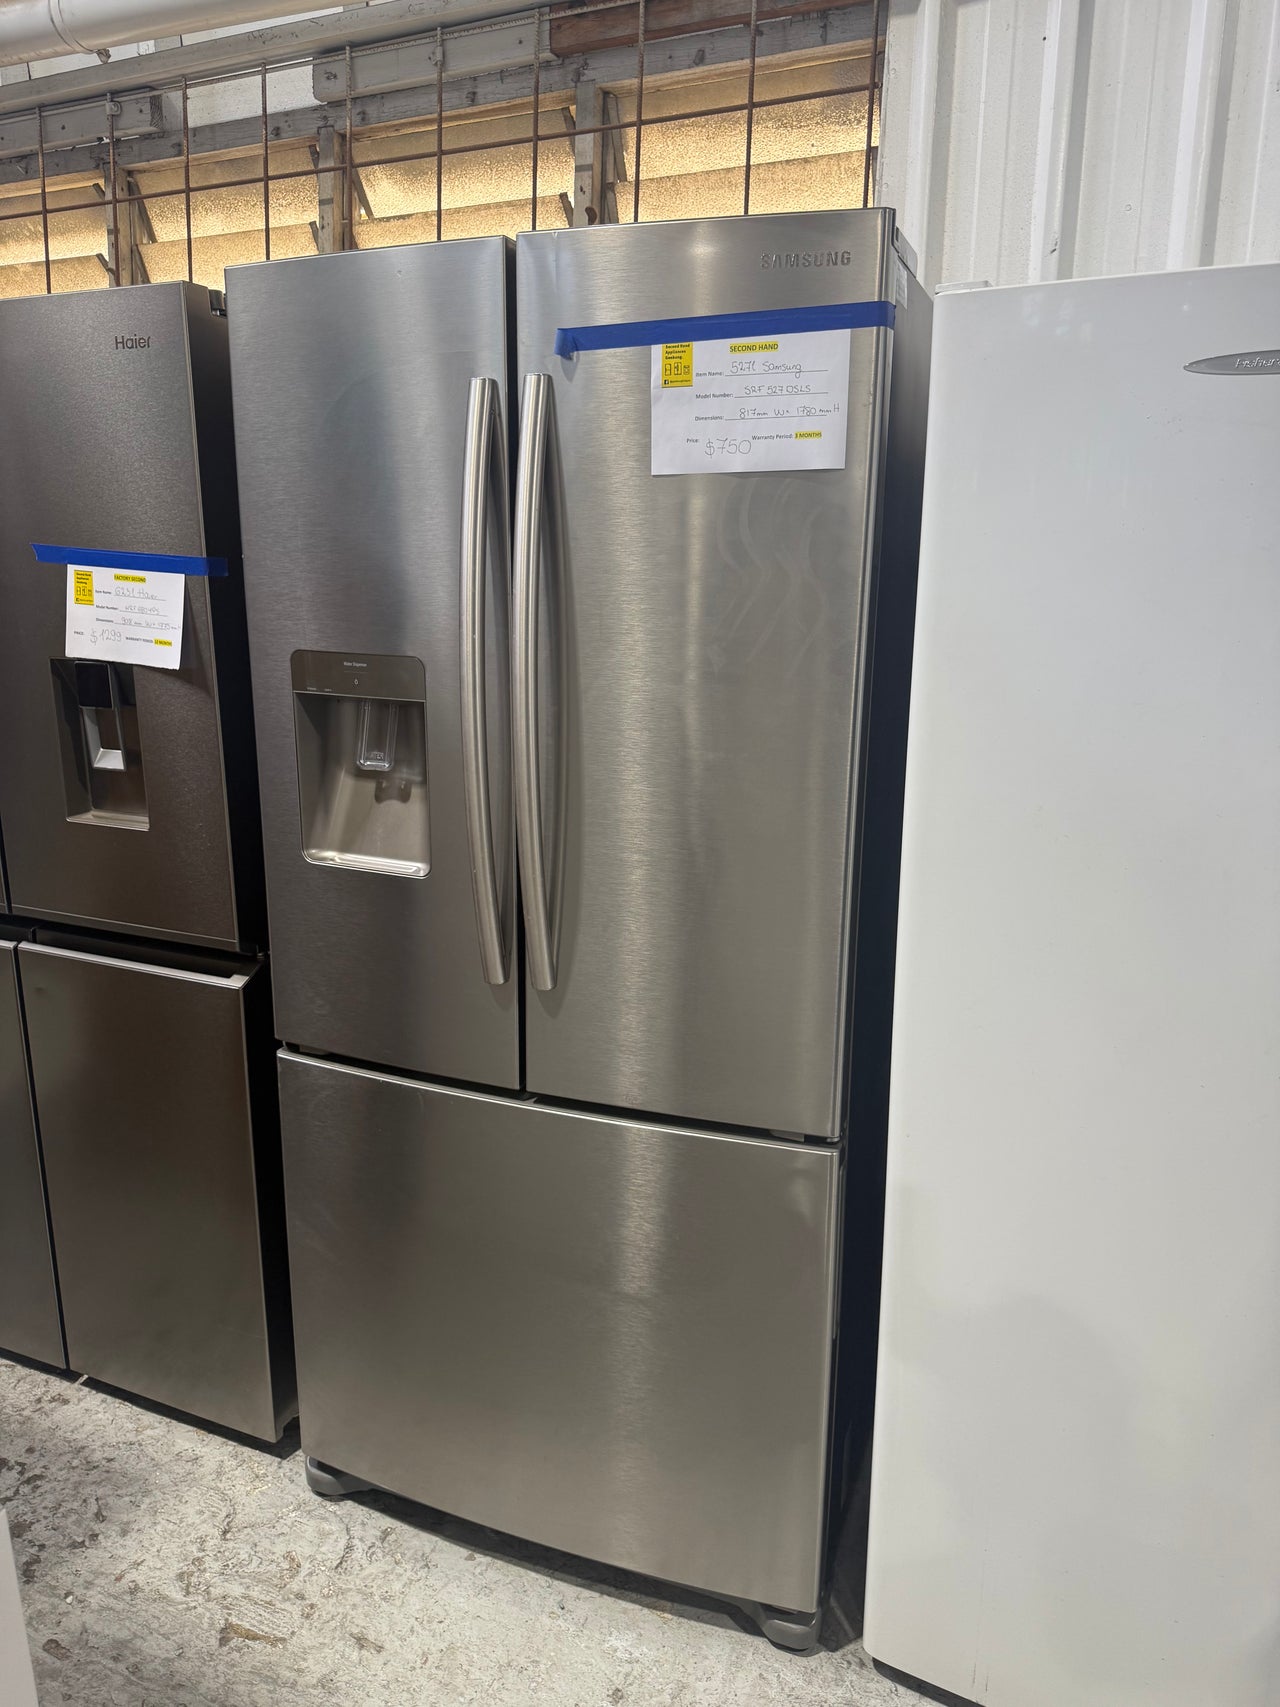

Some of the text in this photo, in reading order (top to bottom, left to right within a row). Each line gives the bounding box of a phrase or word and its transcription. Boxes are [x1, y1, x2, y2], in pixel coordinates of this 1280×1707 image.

[760, 250, 851, 269] SAMSUNG
[114, 334, 150, 350] Haier
[730, 344, 756, 353] SECOND
[762, 361, 802, 379] Samsung
[704, 438, 752, 458] $750
